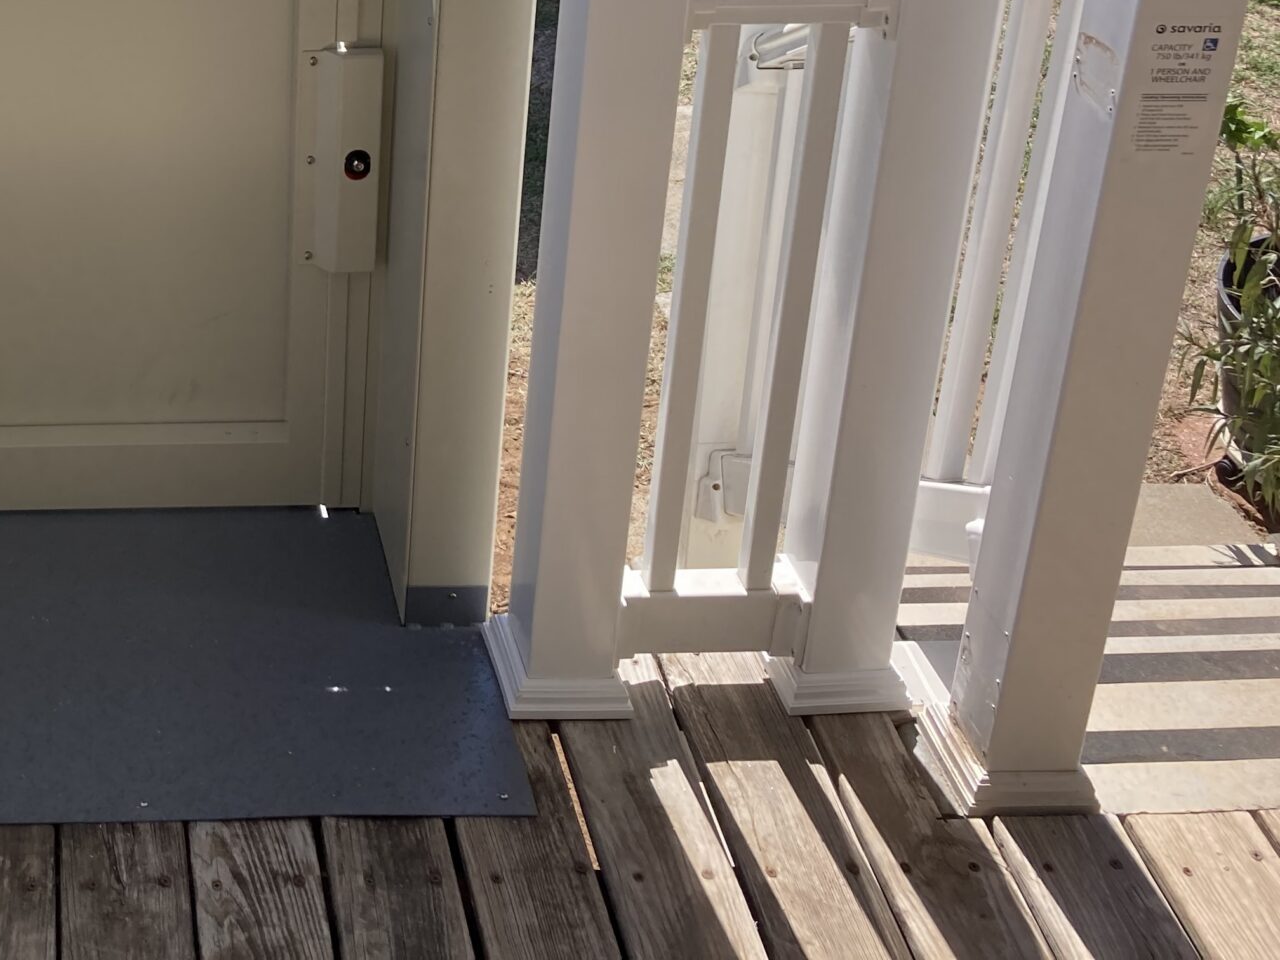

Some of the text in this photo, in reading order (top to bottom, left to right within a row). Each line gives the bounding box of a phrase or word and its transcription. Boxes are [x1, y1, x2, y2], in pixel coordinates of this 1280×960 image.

[1170, 23, 1222, 34] savaria
[1152, 44, 1193, 52] CAPACITY
[1156, 68, 1190, 76] PERSON
[1191, 68, 1212, 76] AND
